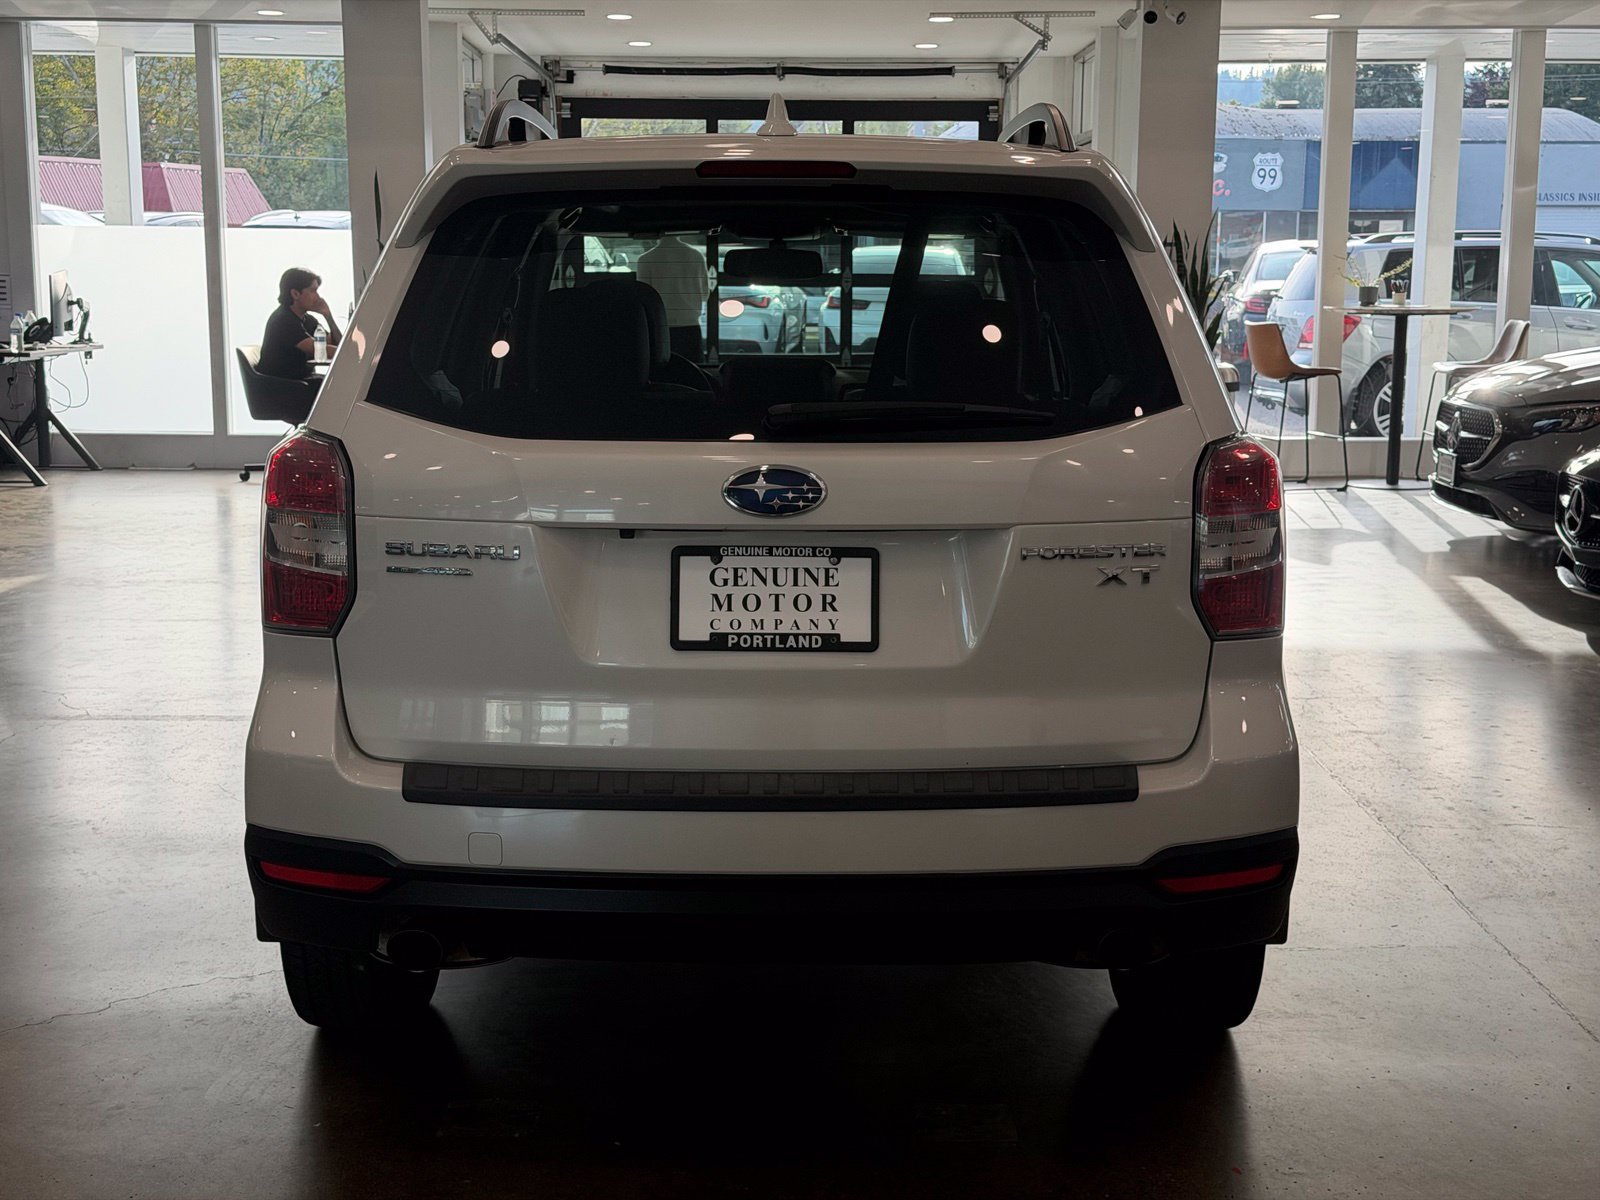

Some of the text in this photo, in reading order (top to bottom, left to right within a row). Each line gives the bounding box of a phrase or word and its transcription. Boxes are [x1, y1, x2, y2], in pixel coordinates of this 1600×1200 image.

[1257, 168, 1278, 185] 99
[1536, 192, 1575, 202] LASSICS
[385, 540, 521, 560] SUBARU
[720, 546, 832, 557] GENUINE MOTOR CO
[1021, 543, 1166, 561] FORESTER
[709, 566, 840, 588] GENUINE
[1096, 564, 1160, 587] XT
[711, 593, 839, 613] MOTOR
[709, 618, 840, 631] COMPANY
[727, 634, 823, 649] PORTLAND
